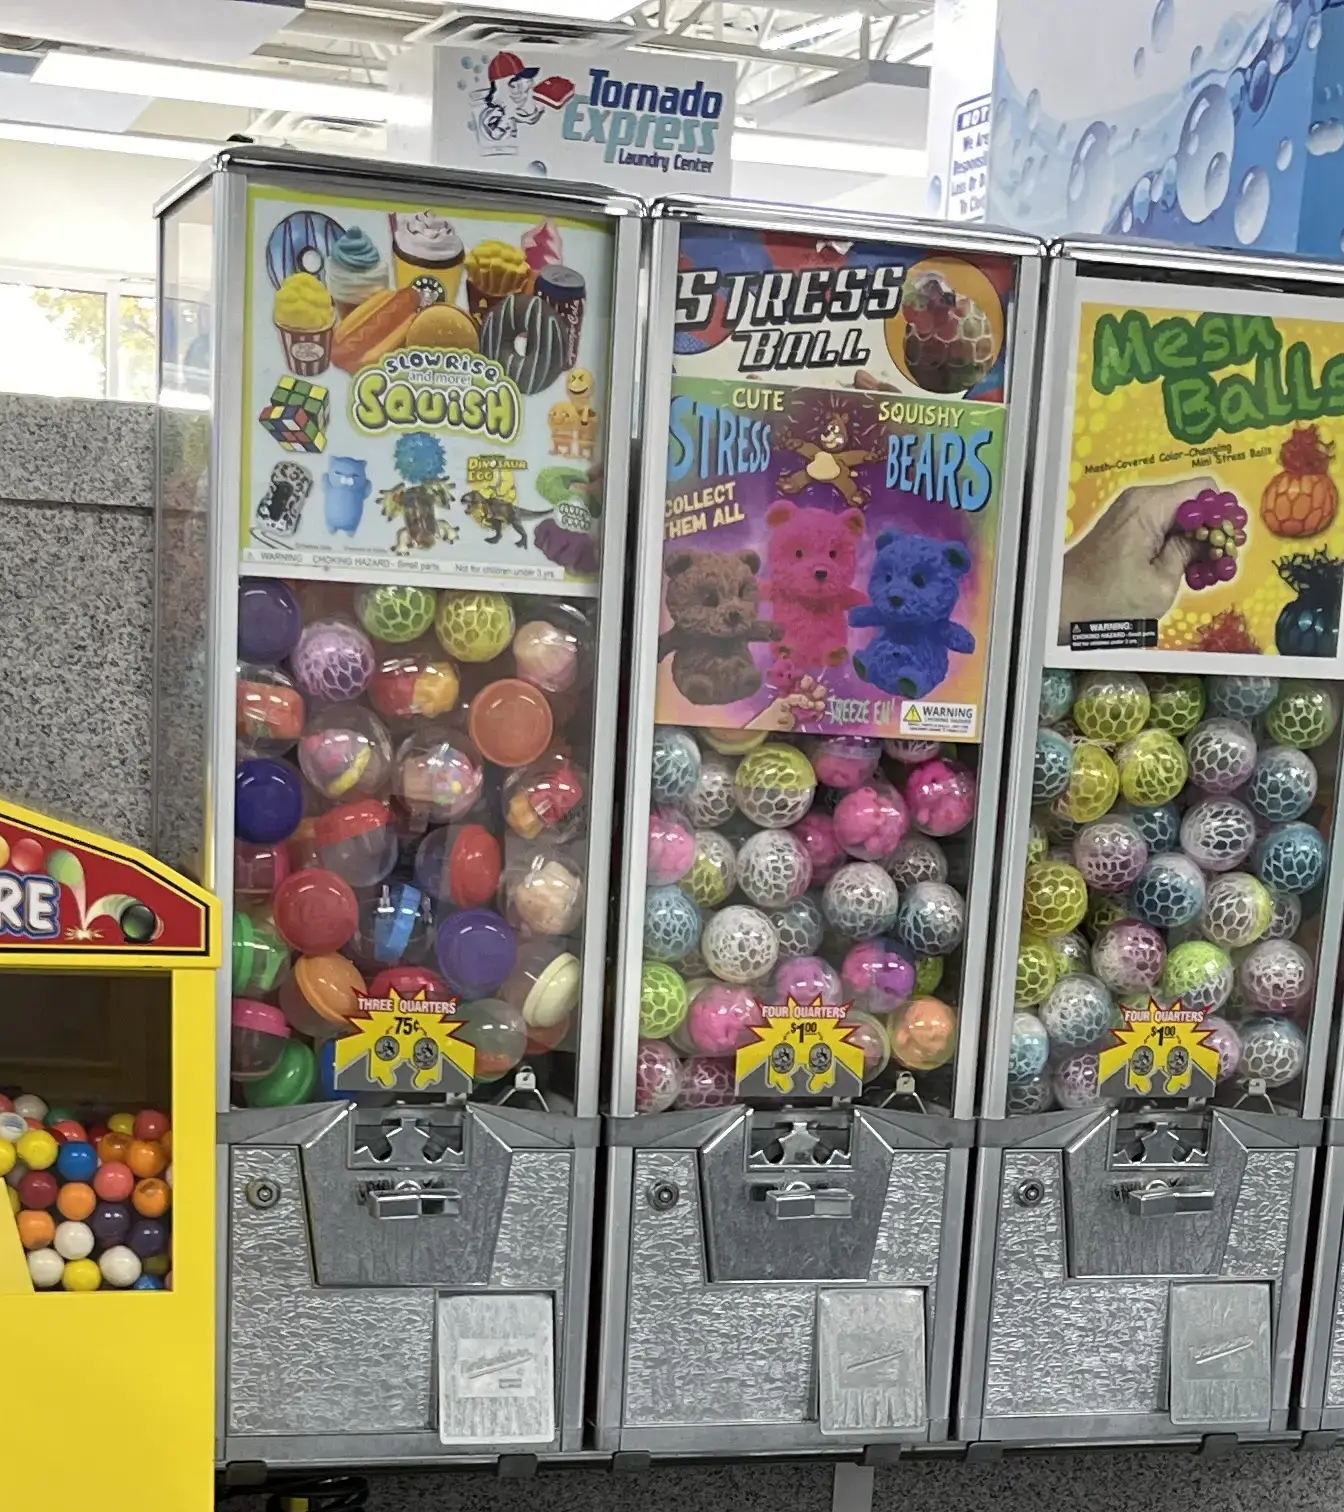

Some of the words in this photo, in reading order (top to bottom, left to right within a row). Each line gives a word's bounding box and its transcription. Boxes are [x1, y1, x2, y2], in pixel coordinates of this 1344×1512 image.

[589, 67, 723, 119] Tornado
[562, 95, 720, 163] Express
[618, 148, 670, 172] Laundry
[674, 154, 714, 173] Center
[675, 266, 904, 329] STRESS
[736, 328, 872, 373] BALL
[1096, 311, 1279, 391] Mesh
[409, 371, 434, 383] and
[732, 388, 785, 411] CUTE
[878, 402, 964, 428] SQUISHY
[668, 395, 771, 483] STRESS
[886, 429, 993, 512] BEARS
[1085, 455, 1156, 474] Mesh-Covered
[1159, 443, 1232, 463] Color-Changing
[1191, 456, 1212, 468] Mini
[1215, 452, 1246, 465] Stress
[665, 482, 737, 514] COLLECT
[664, 513, 707, 541] THEM
[713, 503, 744, 528] ALL
[260, 552, 303, 563] WARNING
[923, 706, 973, 719] WARNING
[358, 998, 394, 1012] THREE
[399, 1000, 456, 1015] QUARTERS
[762, 1006, 789, 1018] FOUR
[794, 1006, 846, 1019] QUARTERS
[1125, 1010, 1151, 1022] FOUR
[1155, 1011, 1204, 1023] QUARTERS
[394, 1017, 420, 1036] 75¢
